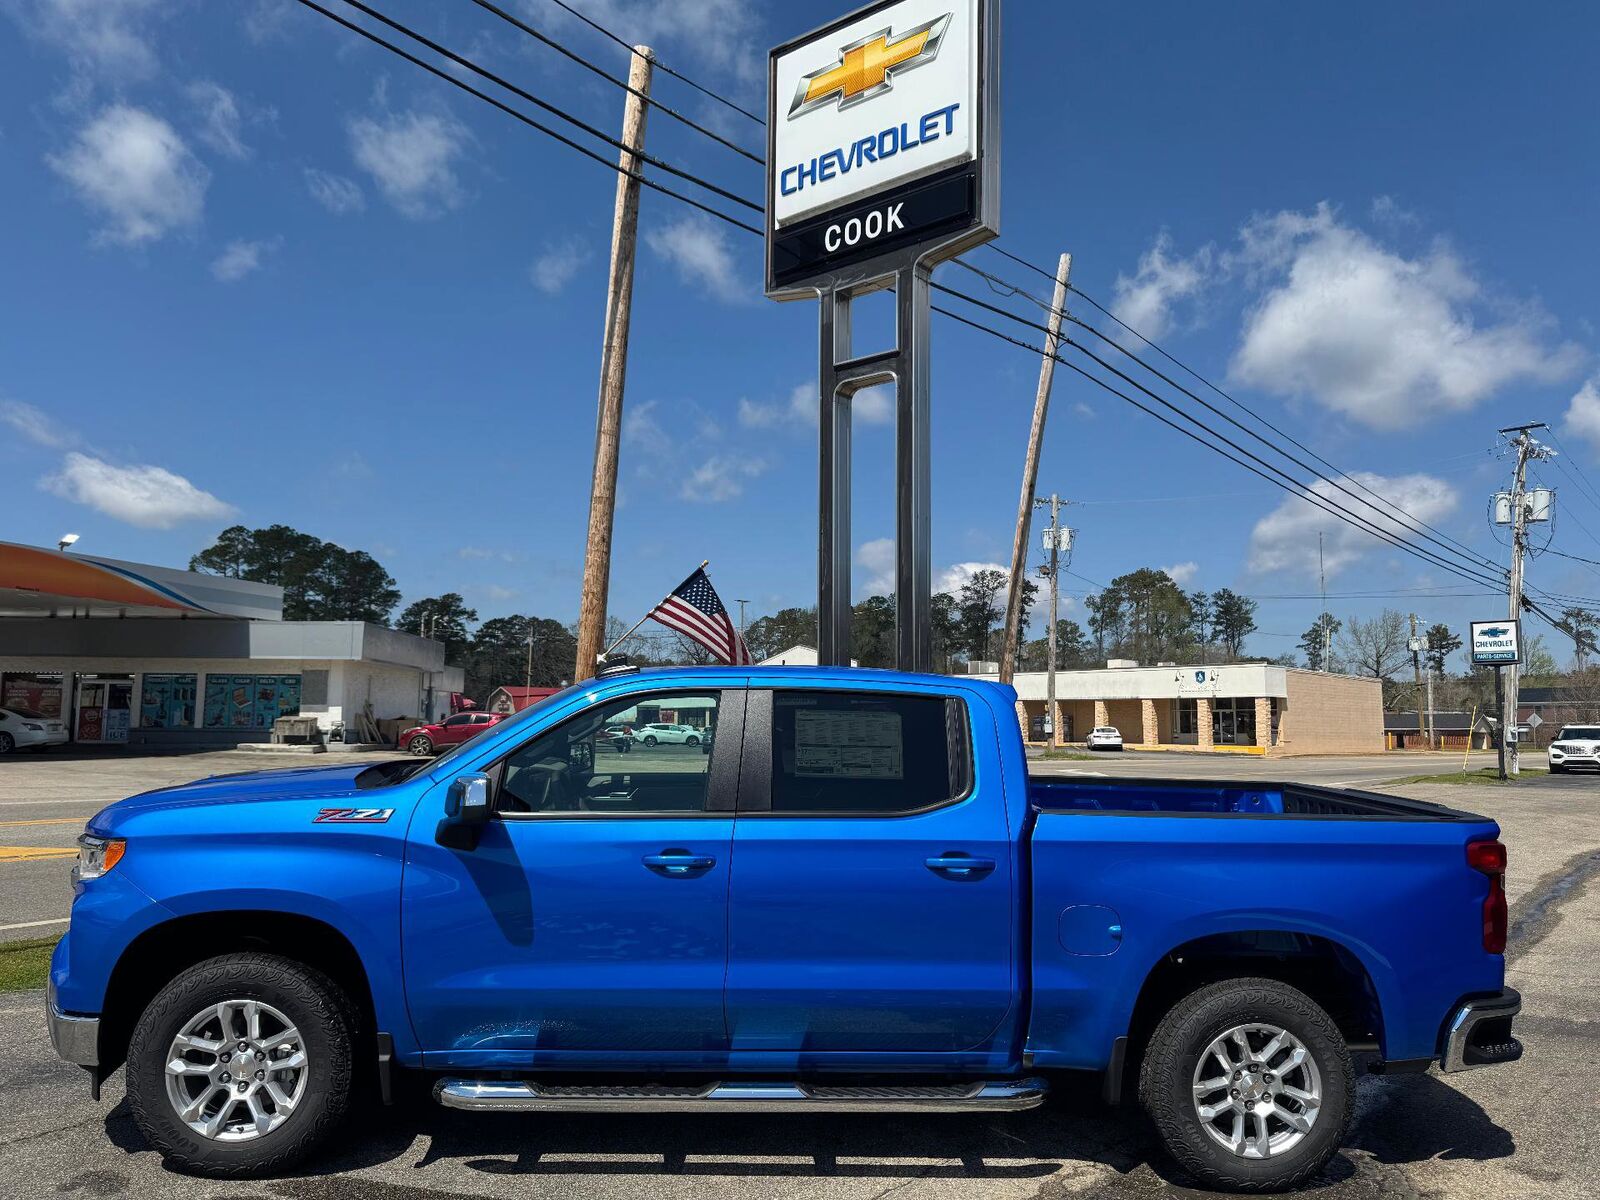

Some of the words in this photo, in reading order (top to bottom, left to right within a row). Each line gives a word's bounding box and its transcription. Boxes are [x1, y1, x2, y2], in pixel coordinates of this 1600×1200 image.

[780, 102, 961, 196] CHEVROLET
[824, 202, 905, 252] COOK
[1475, 640, 1513, 648] CHEVROLET
